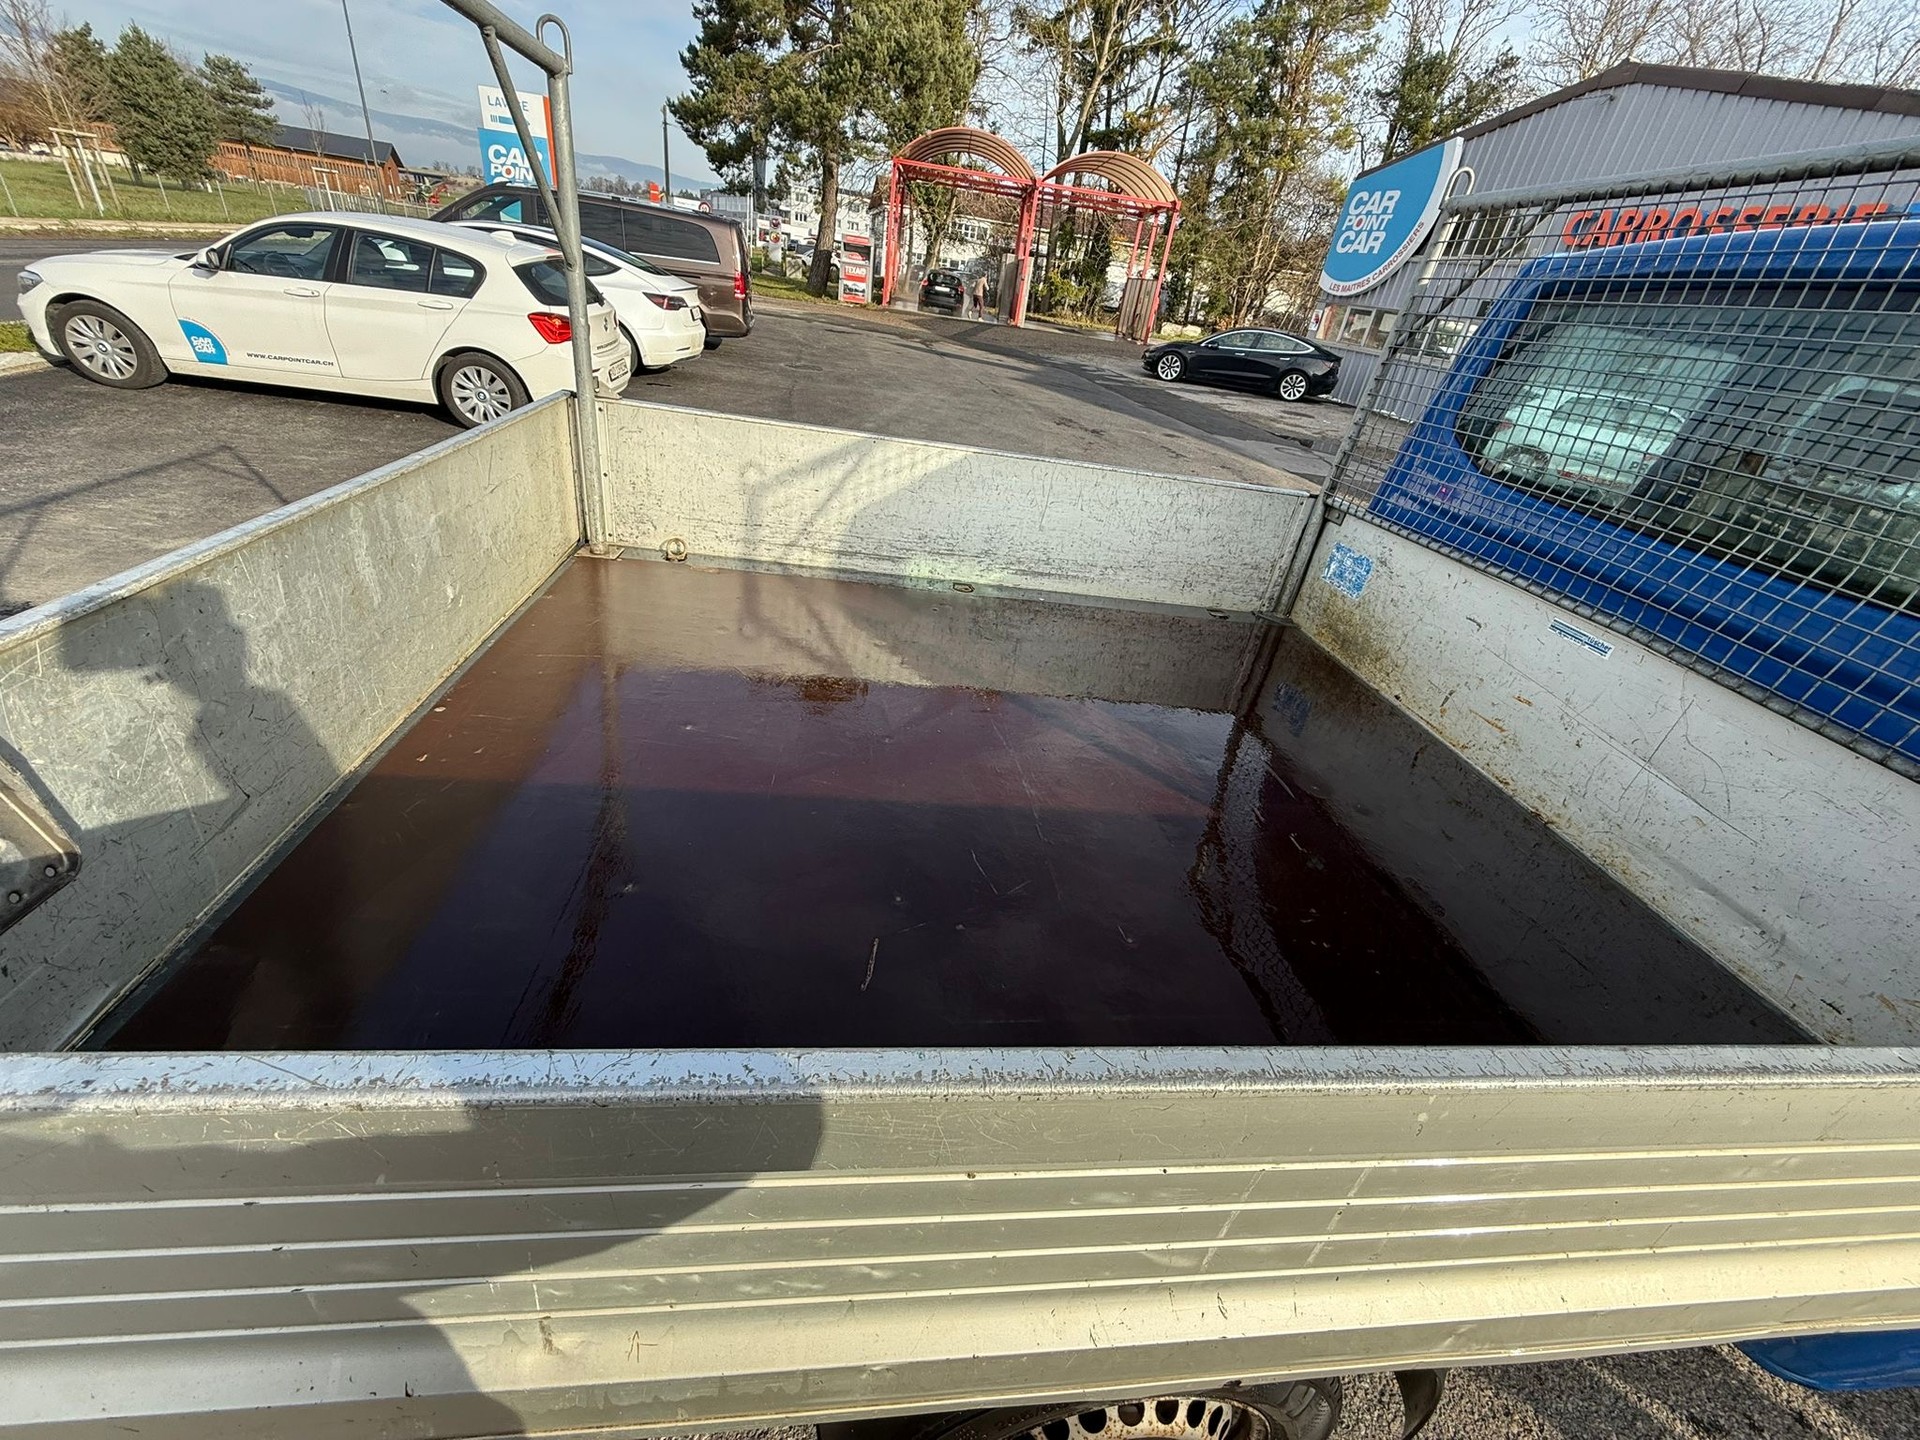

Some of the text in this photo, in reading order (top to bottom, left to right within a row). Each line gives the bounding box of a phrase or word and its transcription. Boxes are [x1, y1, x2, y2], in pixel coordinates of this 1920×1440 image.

[490, 163, 534, 181] POIN
[1348, 189, 1400, 215] CAR
[1342, 214, 1393, 231] POINT
[1336, 231, 1386, 254] CAR
[1329, 282, 1341, 293] LES
[1372, 221, 1425, 281] CARROSSIERS
[246, 352, 334, 366] WWW.CARPOINTCAR.CH
